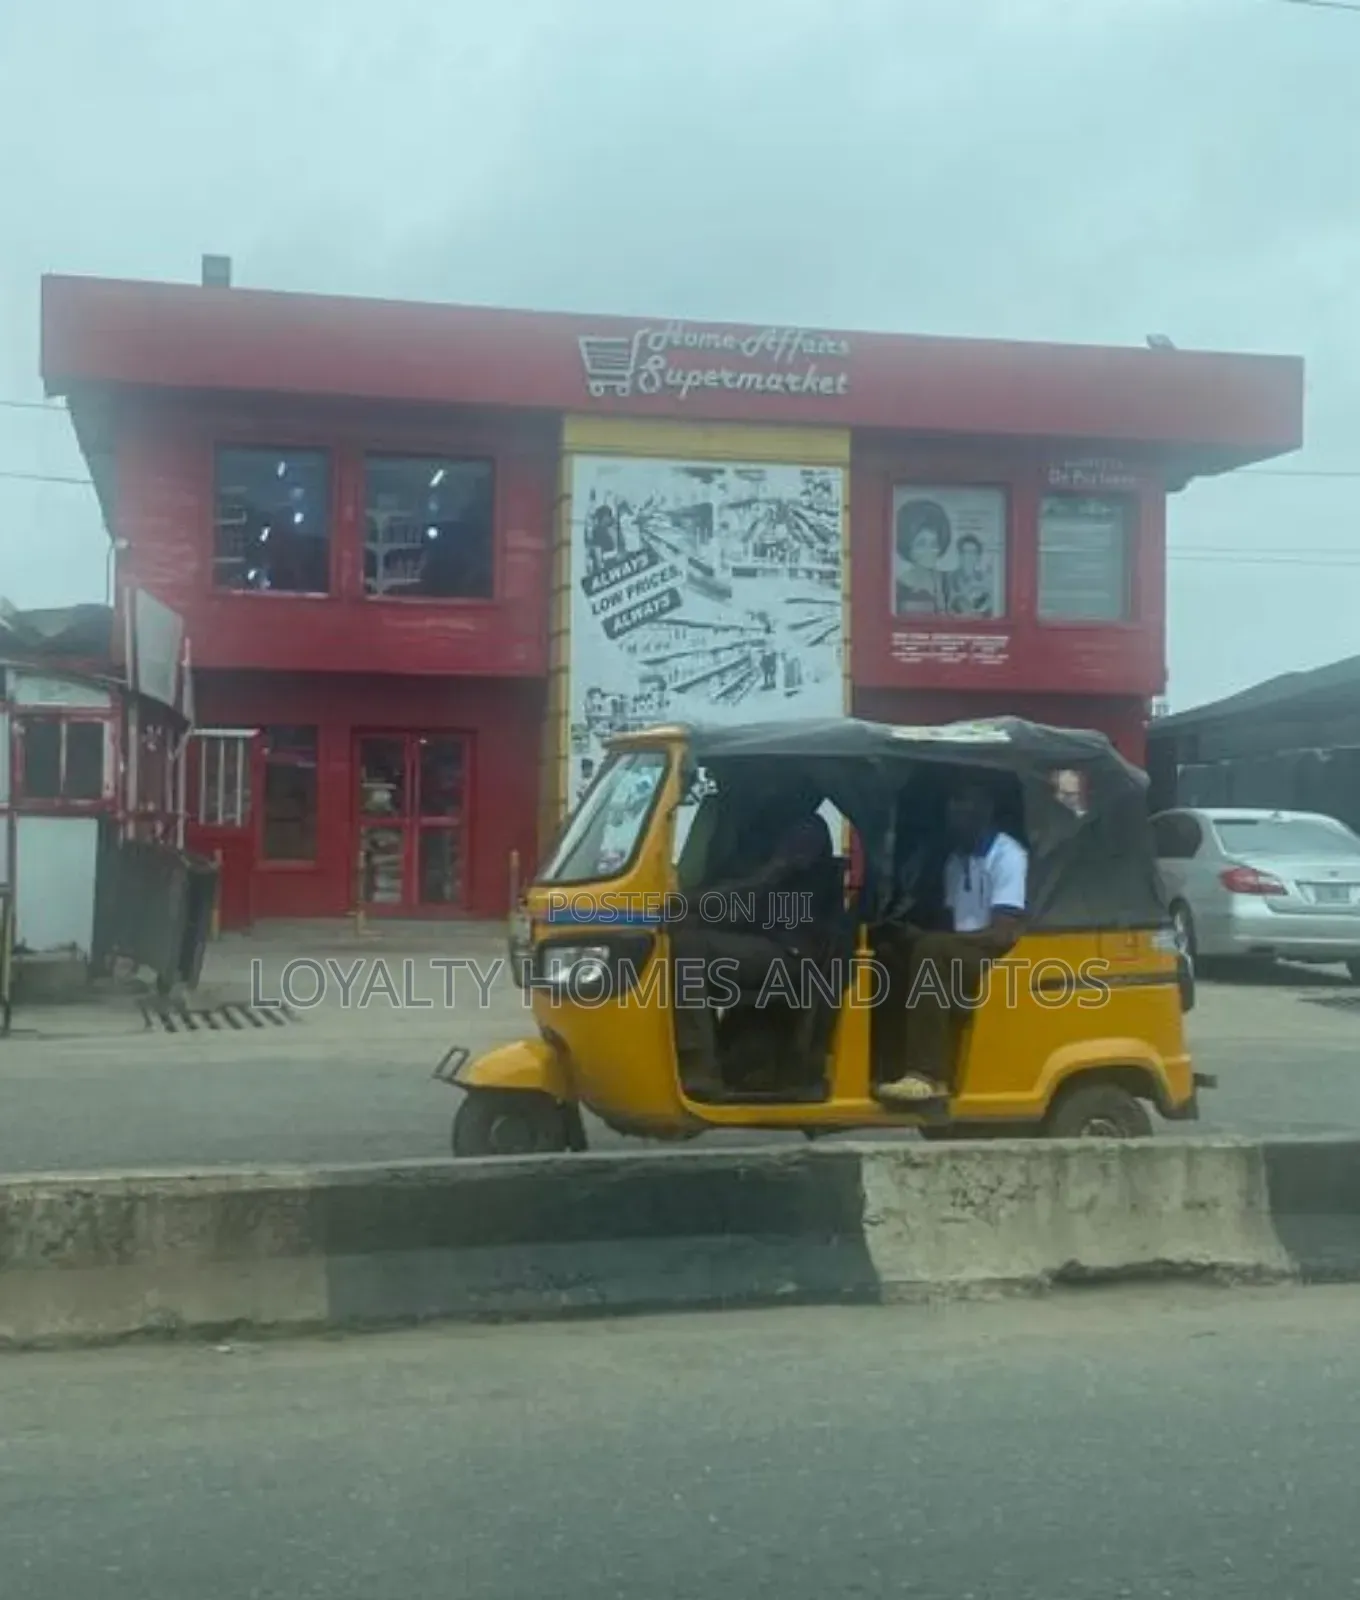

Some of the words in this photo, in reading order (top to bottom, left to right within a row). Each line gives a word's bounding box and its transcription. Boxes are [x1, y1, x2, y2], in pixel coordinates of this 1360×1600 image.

[648, 320, 736, 351] Home
[740, 327, 850, 363] Affairs
[639, 354, 849, 400] Supermarket
[591, 554, 649, 590] ALWAYS
[591, 589, 624, 615] LOW
[613, 595, 670, 631] ALWAYS
